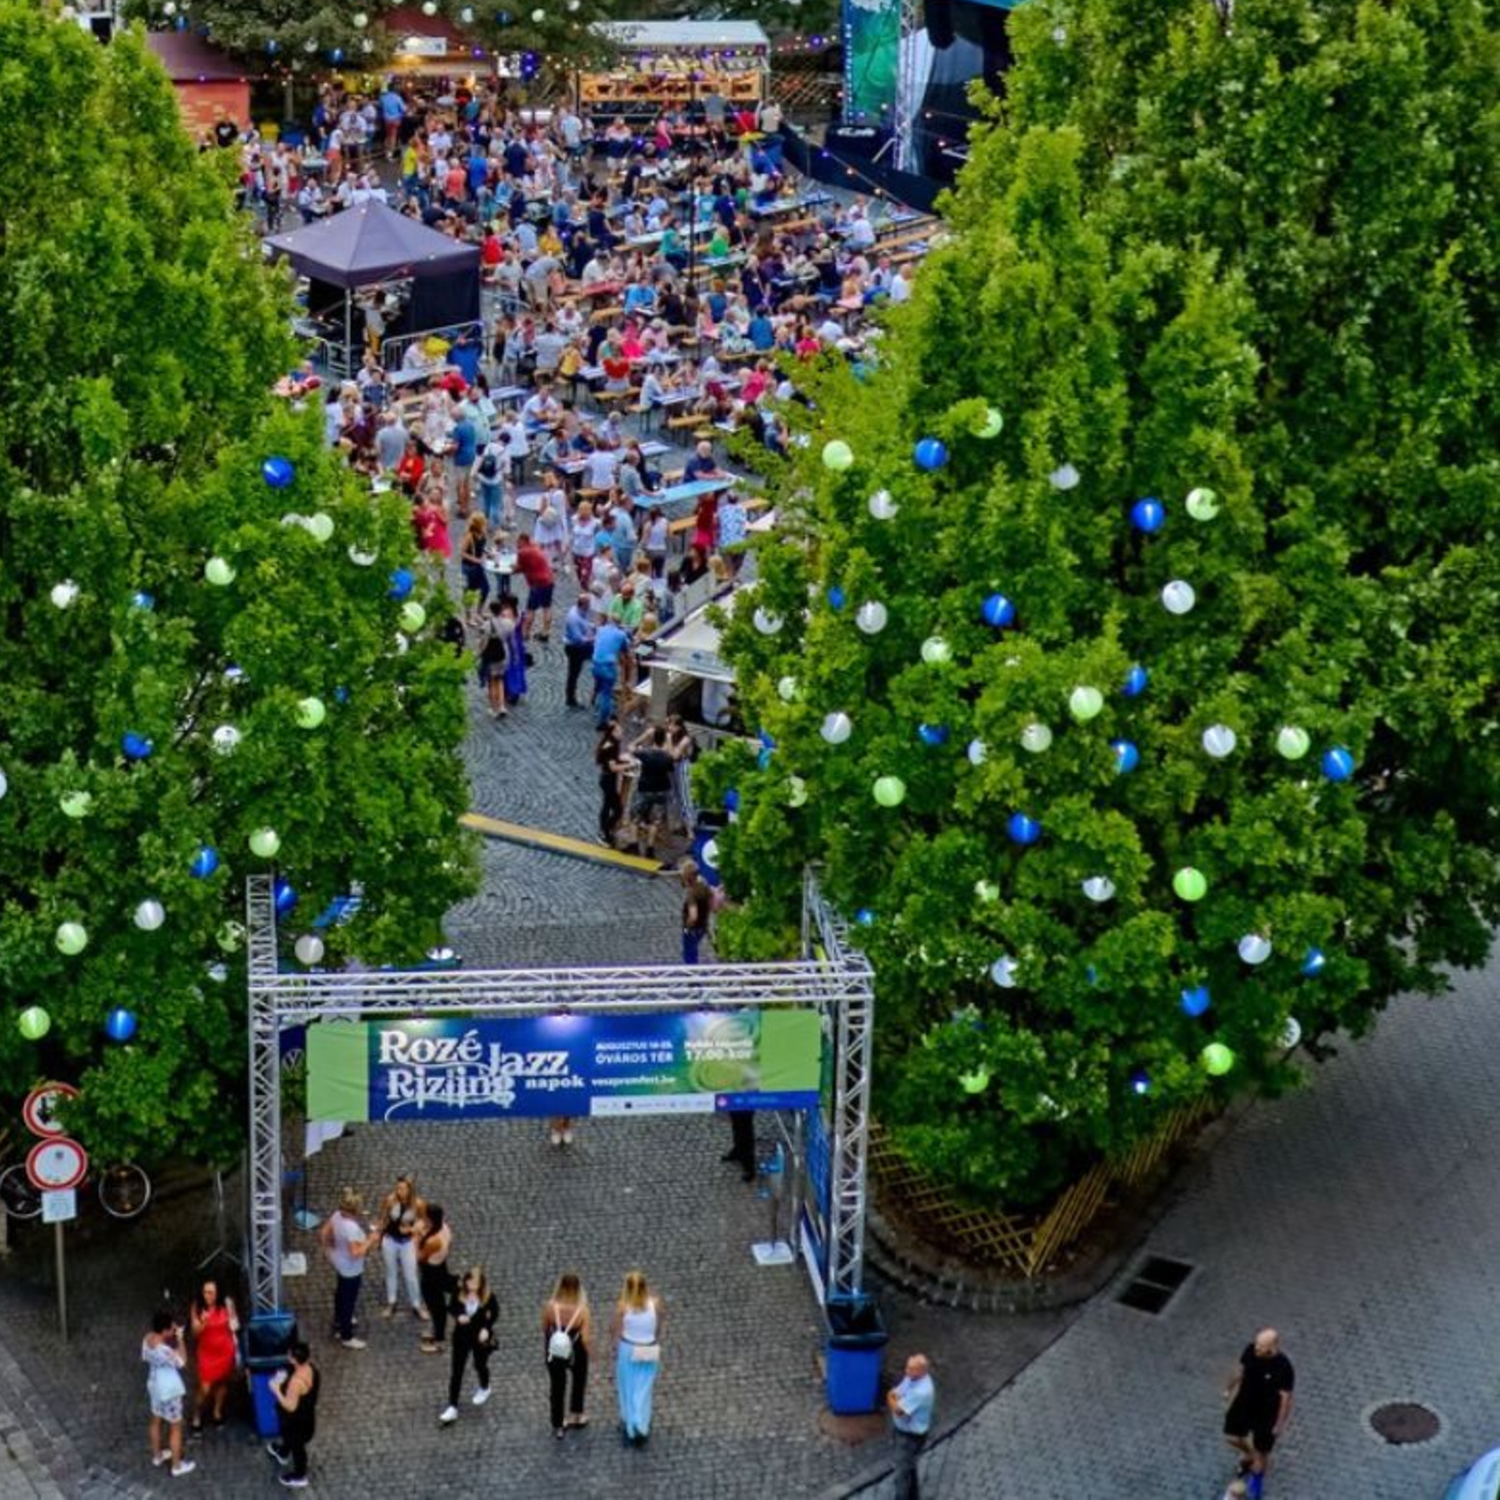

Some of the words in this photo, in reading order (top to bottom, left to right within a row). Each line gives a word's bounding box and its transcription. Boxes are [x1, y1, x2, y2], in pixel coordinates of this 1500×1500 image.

[379, 1029, 483, 1065] Rozé
[488, 1043, 569, 1077] Jazz
[525, 1075, 585, 1092] napok
